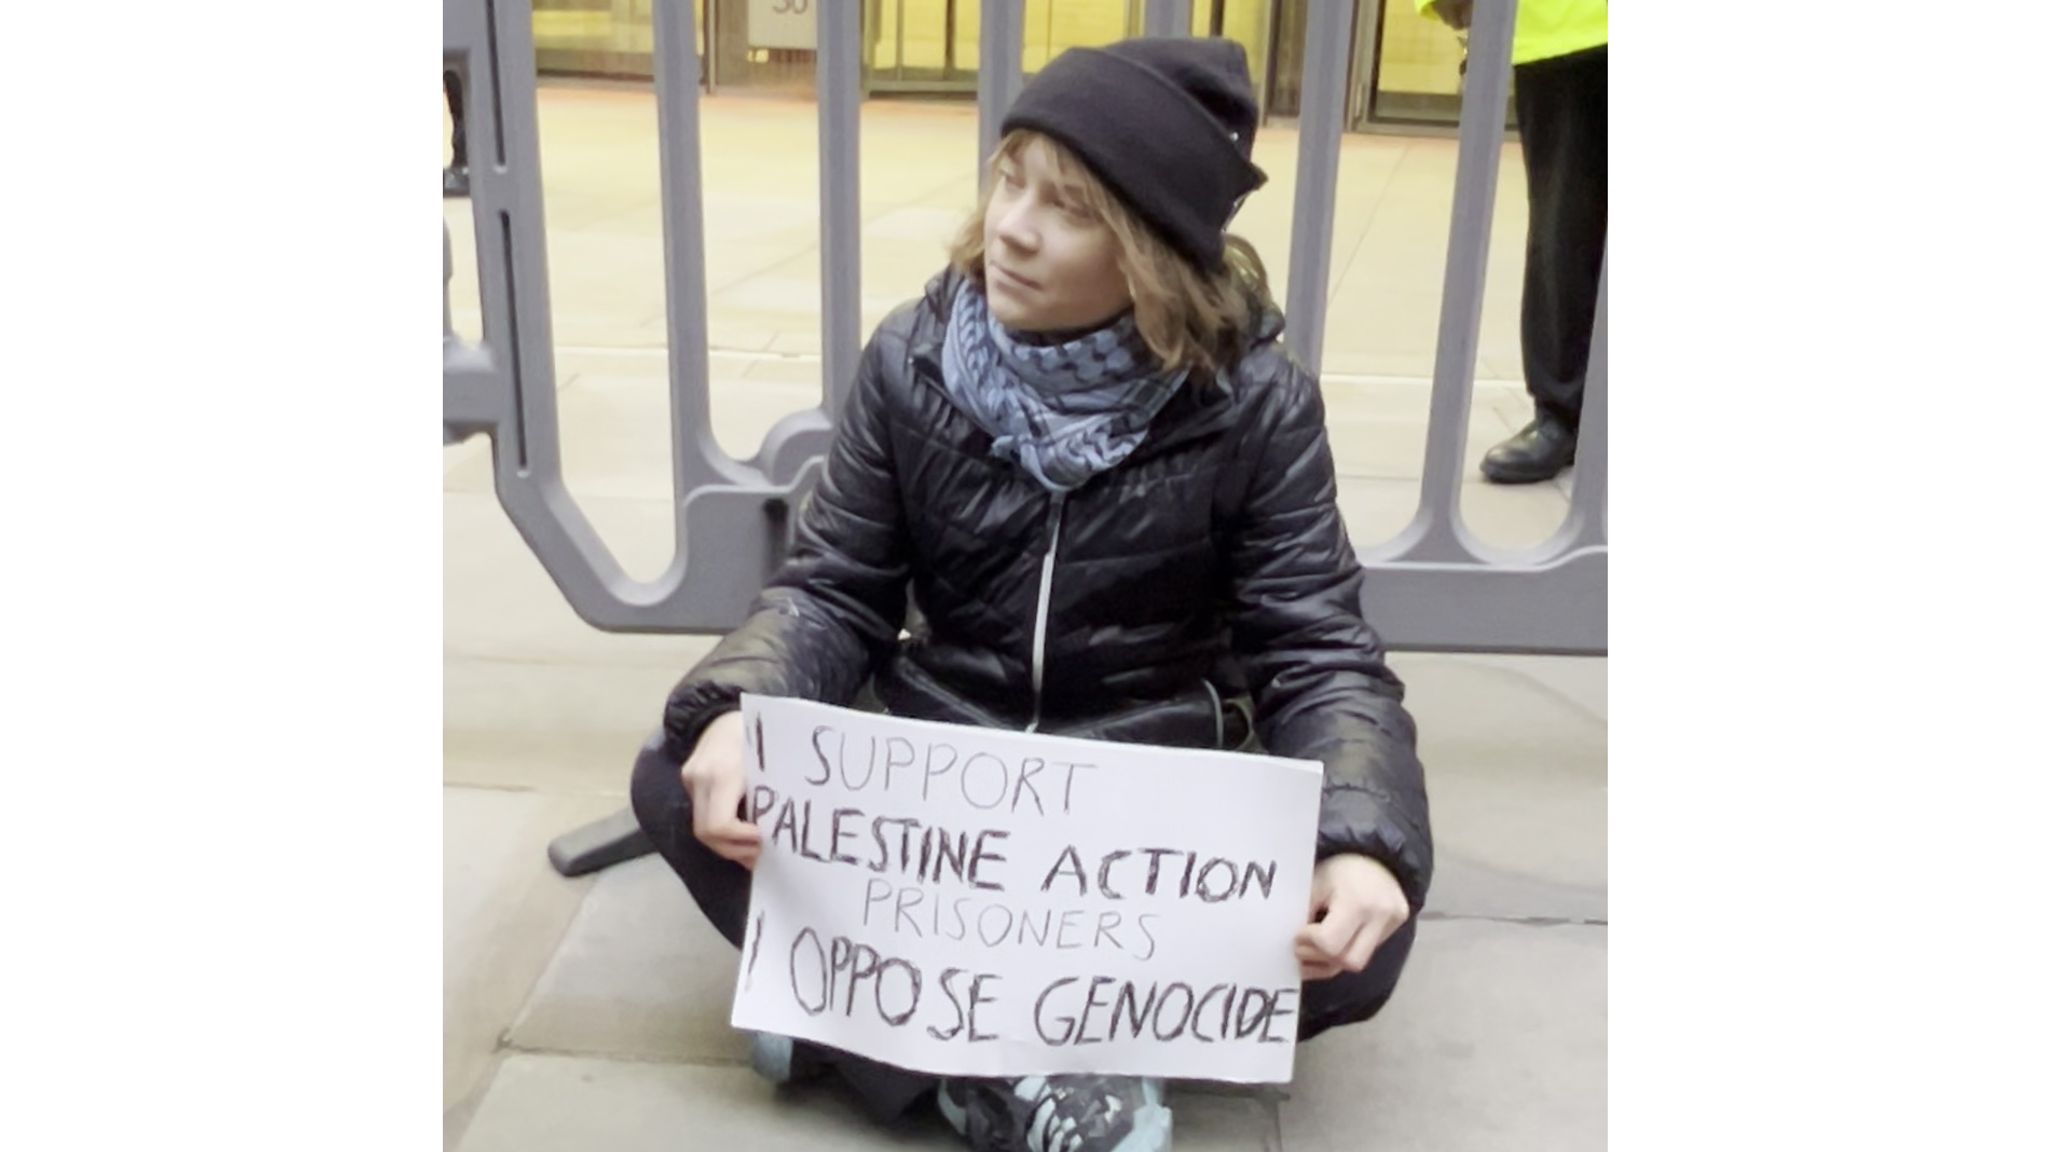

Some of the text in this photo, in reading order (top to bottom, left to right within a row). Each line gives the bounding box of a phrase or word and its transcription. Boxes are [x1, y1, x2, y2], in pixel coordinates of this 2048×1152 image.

[755, 711, 1097, 815] I SUPPORT
[750, 784, 1279, 904] PALESTINE ACTION
[863, 877, 1161, 961] PRISONERS
[746, 910, 1301, 1047] I OPPOSE GENOCIDE
